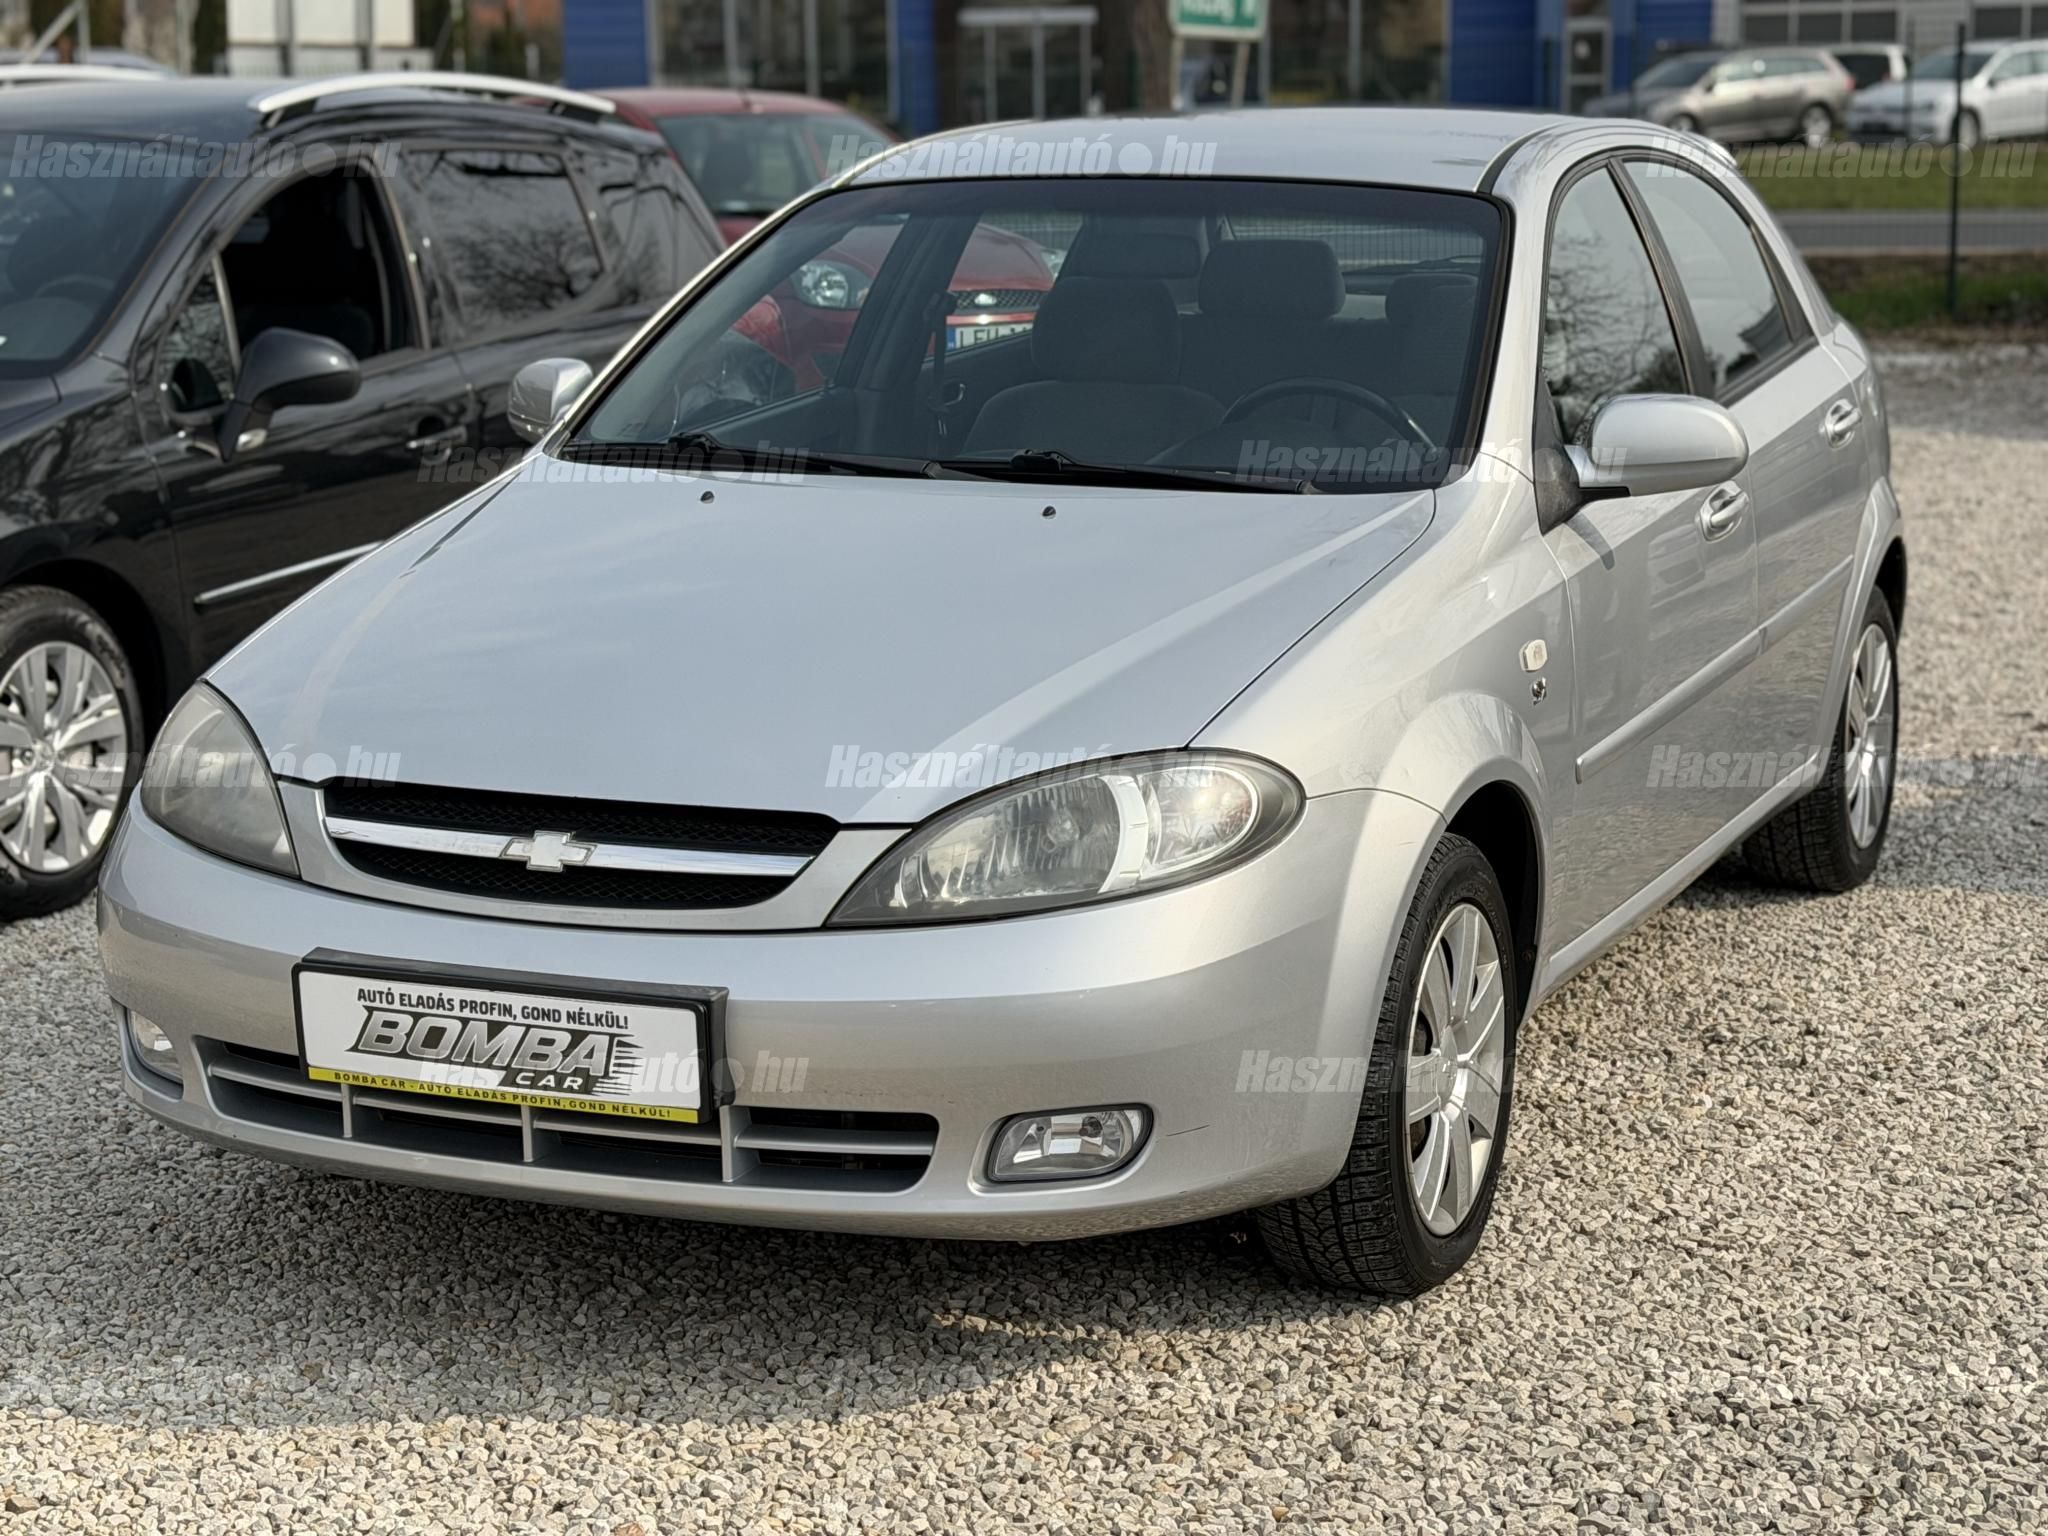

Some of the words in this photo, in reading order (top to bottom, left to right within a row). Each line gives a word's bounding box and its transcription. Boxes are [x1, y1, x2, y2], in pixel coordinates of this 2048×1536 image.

[357, 987, 395, 1006] AUTÓ
[399, 992, 455, 1012] ELADÁS
[459, 999, 518, 1021] PROFIN,
[521, 1005, 562, 1023] GOND
[566, 1006, 629, 1030] NÉLKÜL!
[358, 1010, 610, 1077] BOMBA
[334, 1072, 377, 1085] BOMBA
[381, 1078, 406, 1089] CAR
[515, 1072, 584, 1090] CAR
